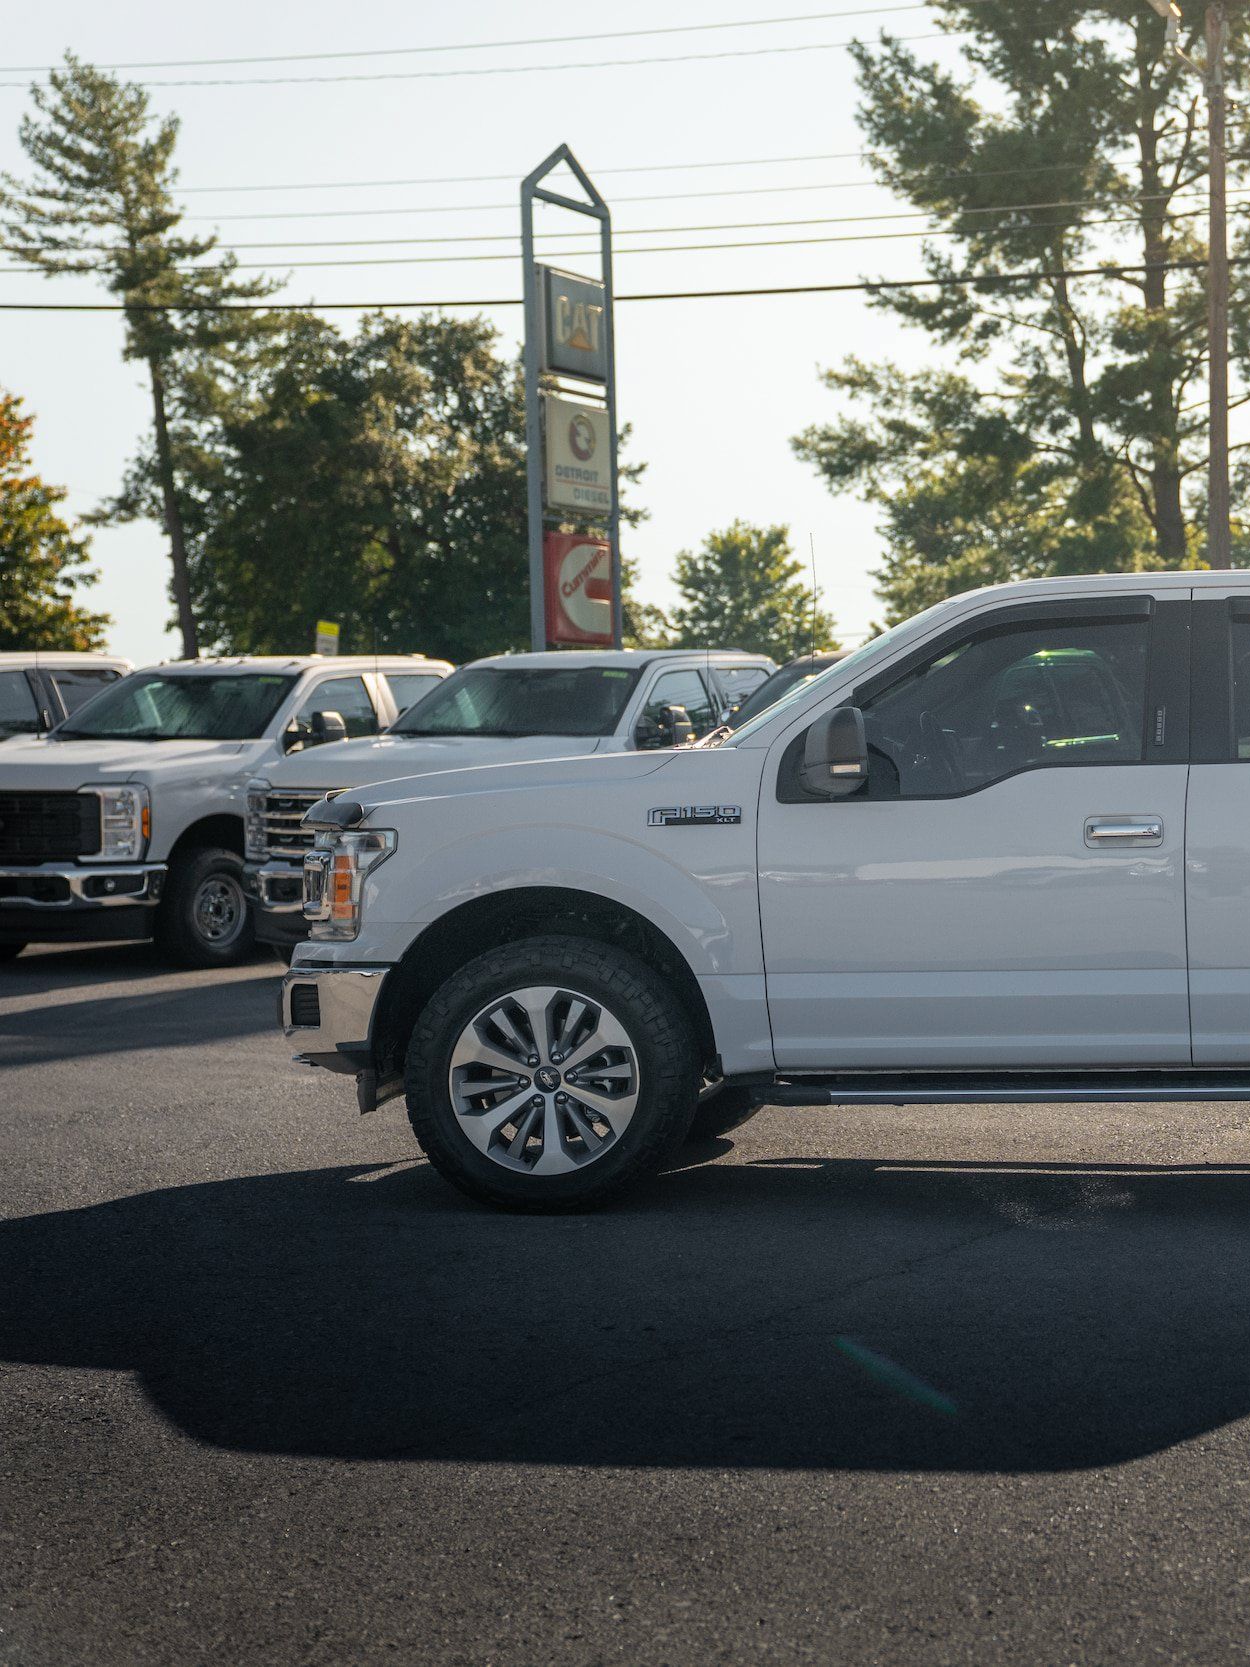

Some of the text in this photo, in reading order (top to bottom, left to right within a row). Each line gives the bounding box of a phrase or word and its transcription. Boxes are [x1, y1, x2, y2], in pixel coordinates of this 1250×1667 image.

[555, 295, 604, 352] CAT
[555, 464, 599, 482] DETROIT
[573, 487, 609, 504] DIESEL
[647, 806, 741, 826] F150
